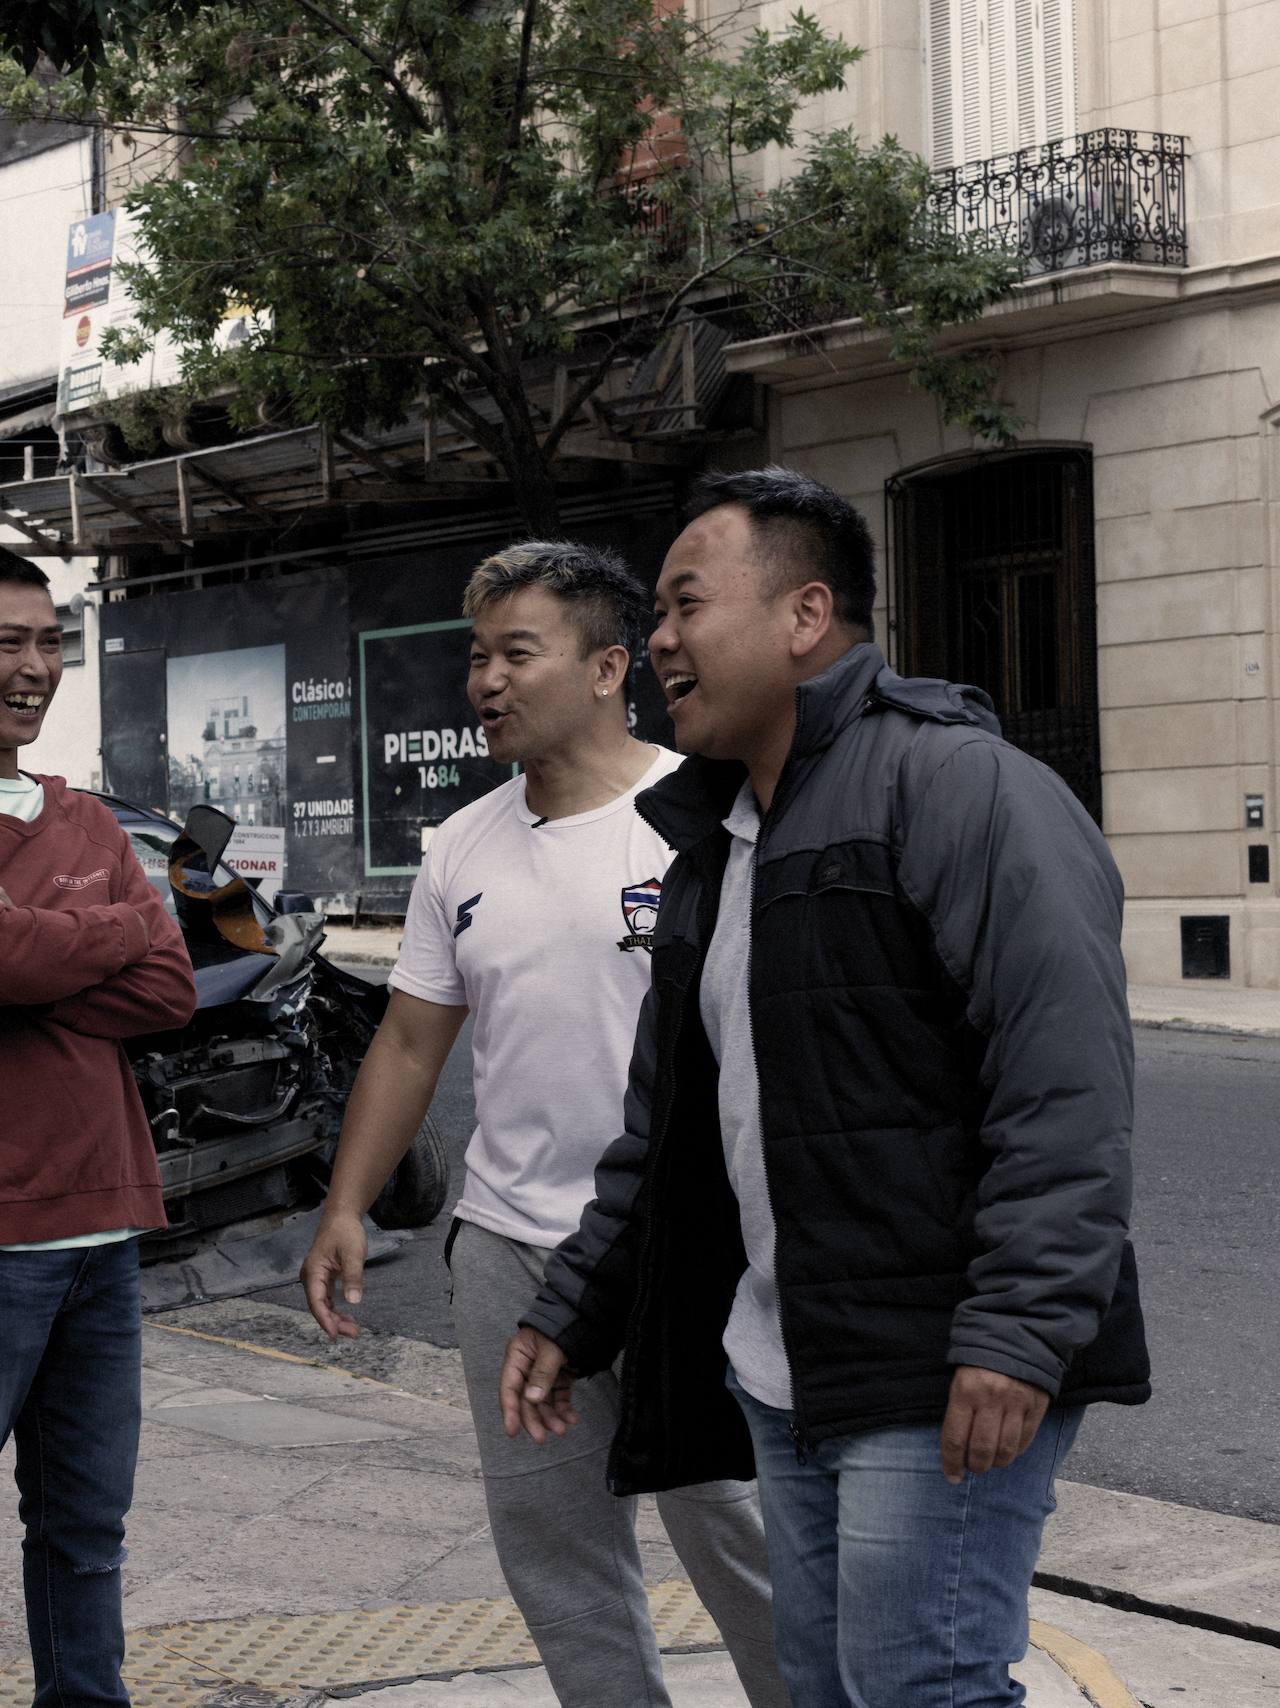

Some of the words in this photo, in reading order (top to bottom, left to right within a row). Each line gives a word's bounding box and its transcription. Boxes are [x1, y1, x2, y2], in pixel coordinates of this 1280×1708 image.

[292, 678, 344, 703] Clásico
[384, 726, 490, 763] PIEDRAS
[418, 764, 460, 789] 1684
[293, 802, 306, 818] 37
[307, 799, 354, 817] UNIDADE
[308, 820, 313, 836] Y
[314, 819, 320, 836] 3
[321, 817, 354, 835] AMBIENT
